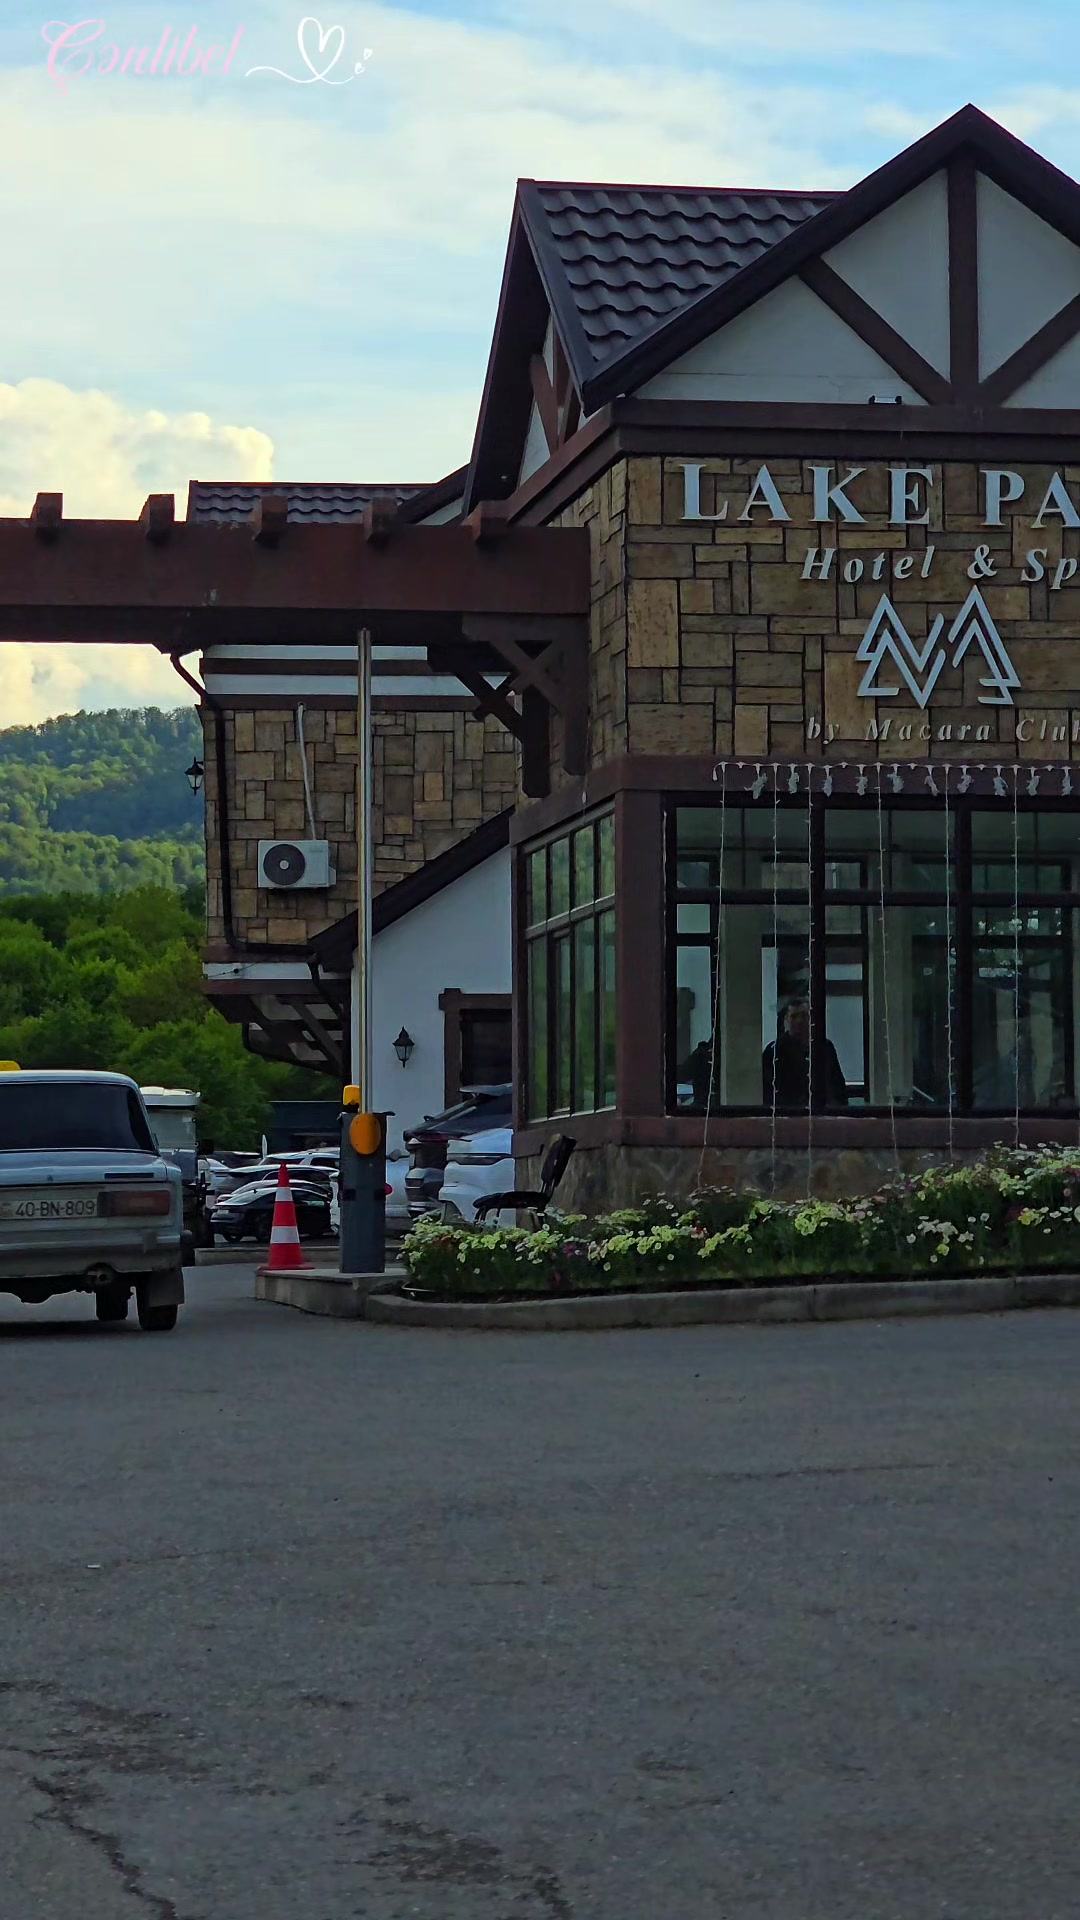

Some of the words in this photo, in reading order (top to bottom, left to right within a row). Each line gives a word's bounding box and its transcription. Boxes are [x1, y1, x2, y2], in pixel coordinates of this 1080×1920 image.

[679, 463, 934, 525] LAKE
[980, 469, 1080, 529] PA
[800, 545, 936, 584] Hotel
[967, 544, 998, 579] &
[1020, 548, 1078, 590] Sp
[807, 716, 840, 745] by
[864, 719, 991, 741] Macara
[15, 1200, 95, 1217] 40-BN-809
